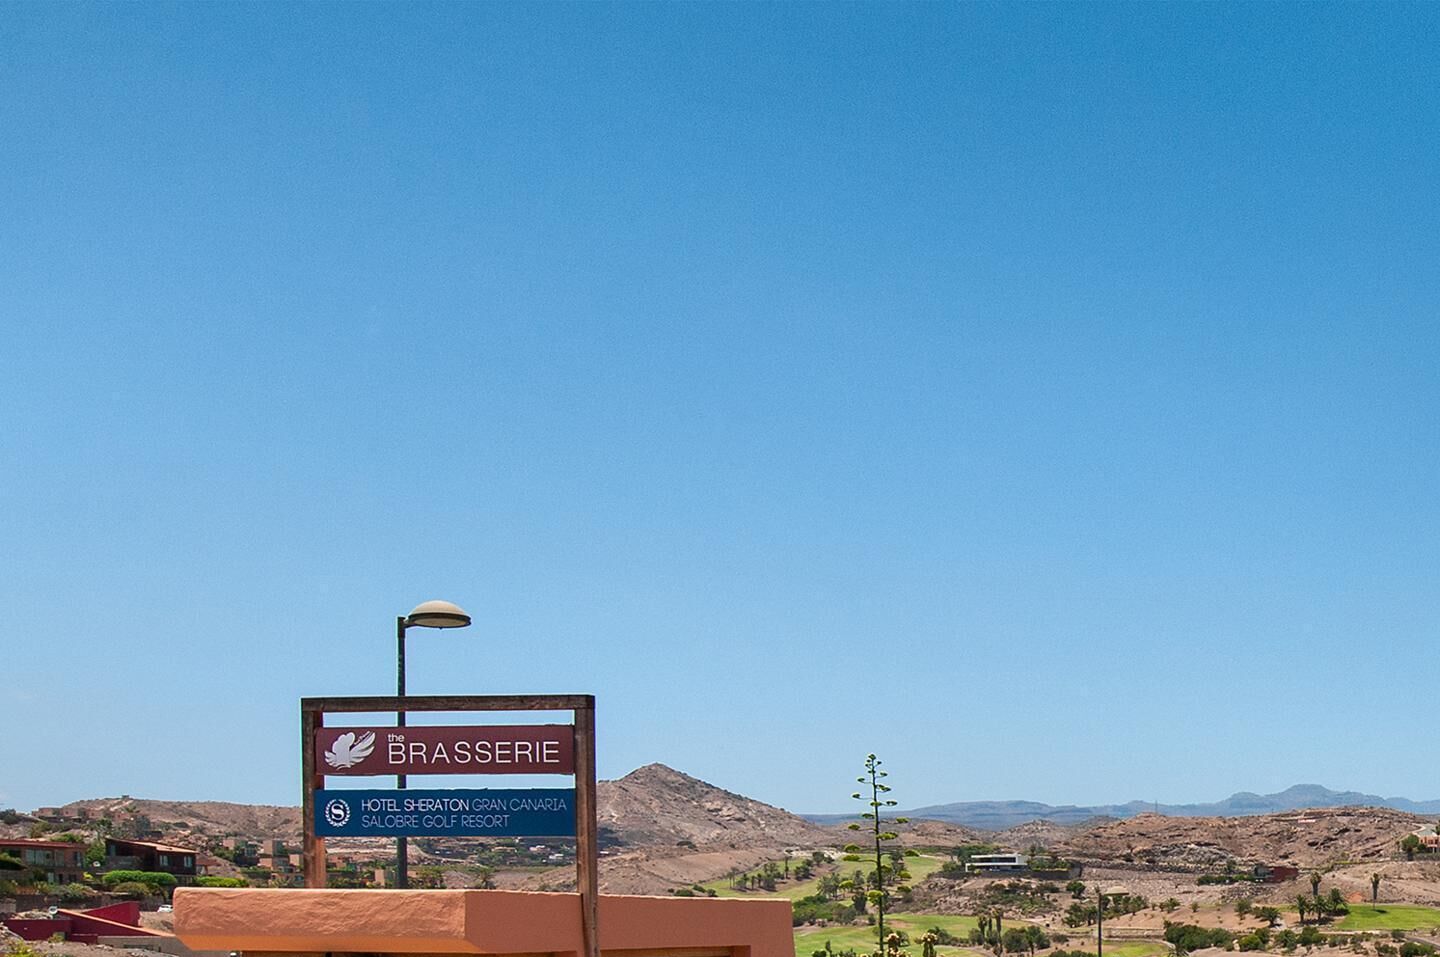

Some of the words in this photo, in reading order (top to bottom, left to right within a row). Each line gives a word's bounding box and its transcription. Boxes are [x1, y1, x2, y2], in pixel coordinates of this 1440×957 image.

[387, 733, 405, 743] the
[388, 741, 560, 764] BRASSERIE
[361, 798, 401, 812] HOTEL
[404, 798, 470, 812] SHERATON
[471, 798, 507, 812] GRAN
[509, 798, 567, 812] CANARIA
[361, 814, 420, 828] SALOBRE
[422, 814, 457, 828] GOLF
[461, 814, 510, 828] RESORT
